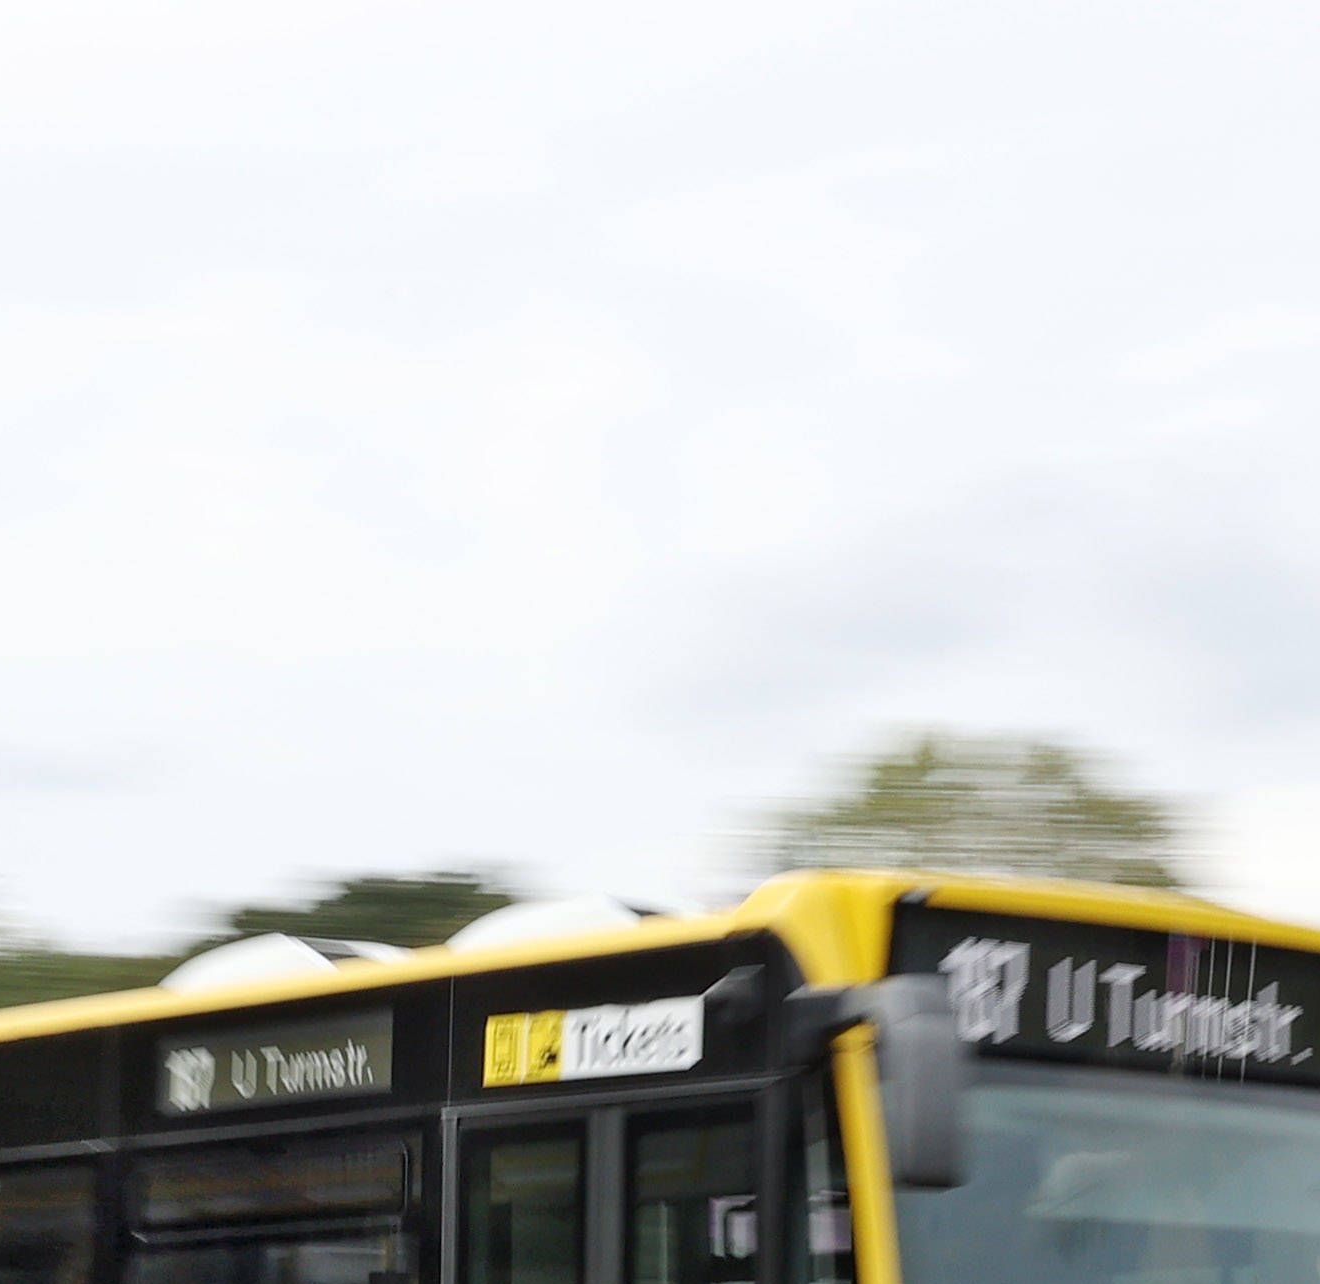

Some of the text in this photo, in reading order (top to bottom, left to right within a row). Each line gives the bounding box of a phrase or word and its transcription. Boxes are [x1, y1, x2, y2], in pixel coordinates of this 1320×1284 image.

[573, 1003, 690, 1072] Tickets
[1046, 956, 1097, 1043] U
[1097, 962, 1314, 1066] Turmstr.
[232, 1049, 258, 1099] U
